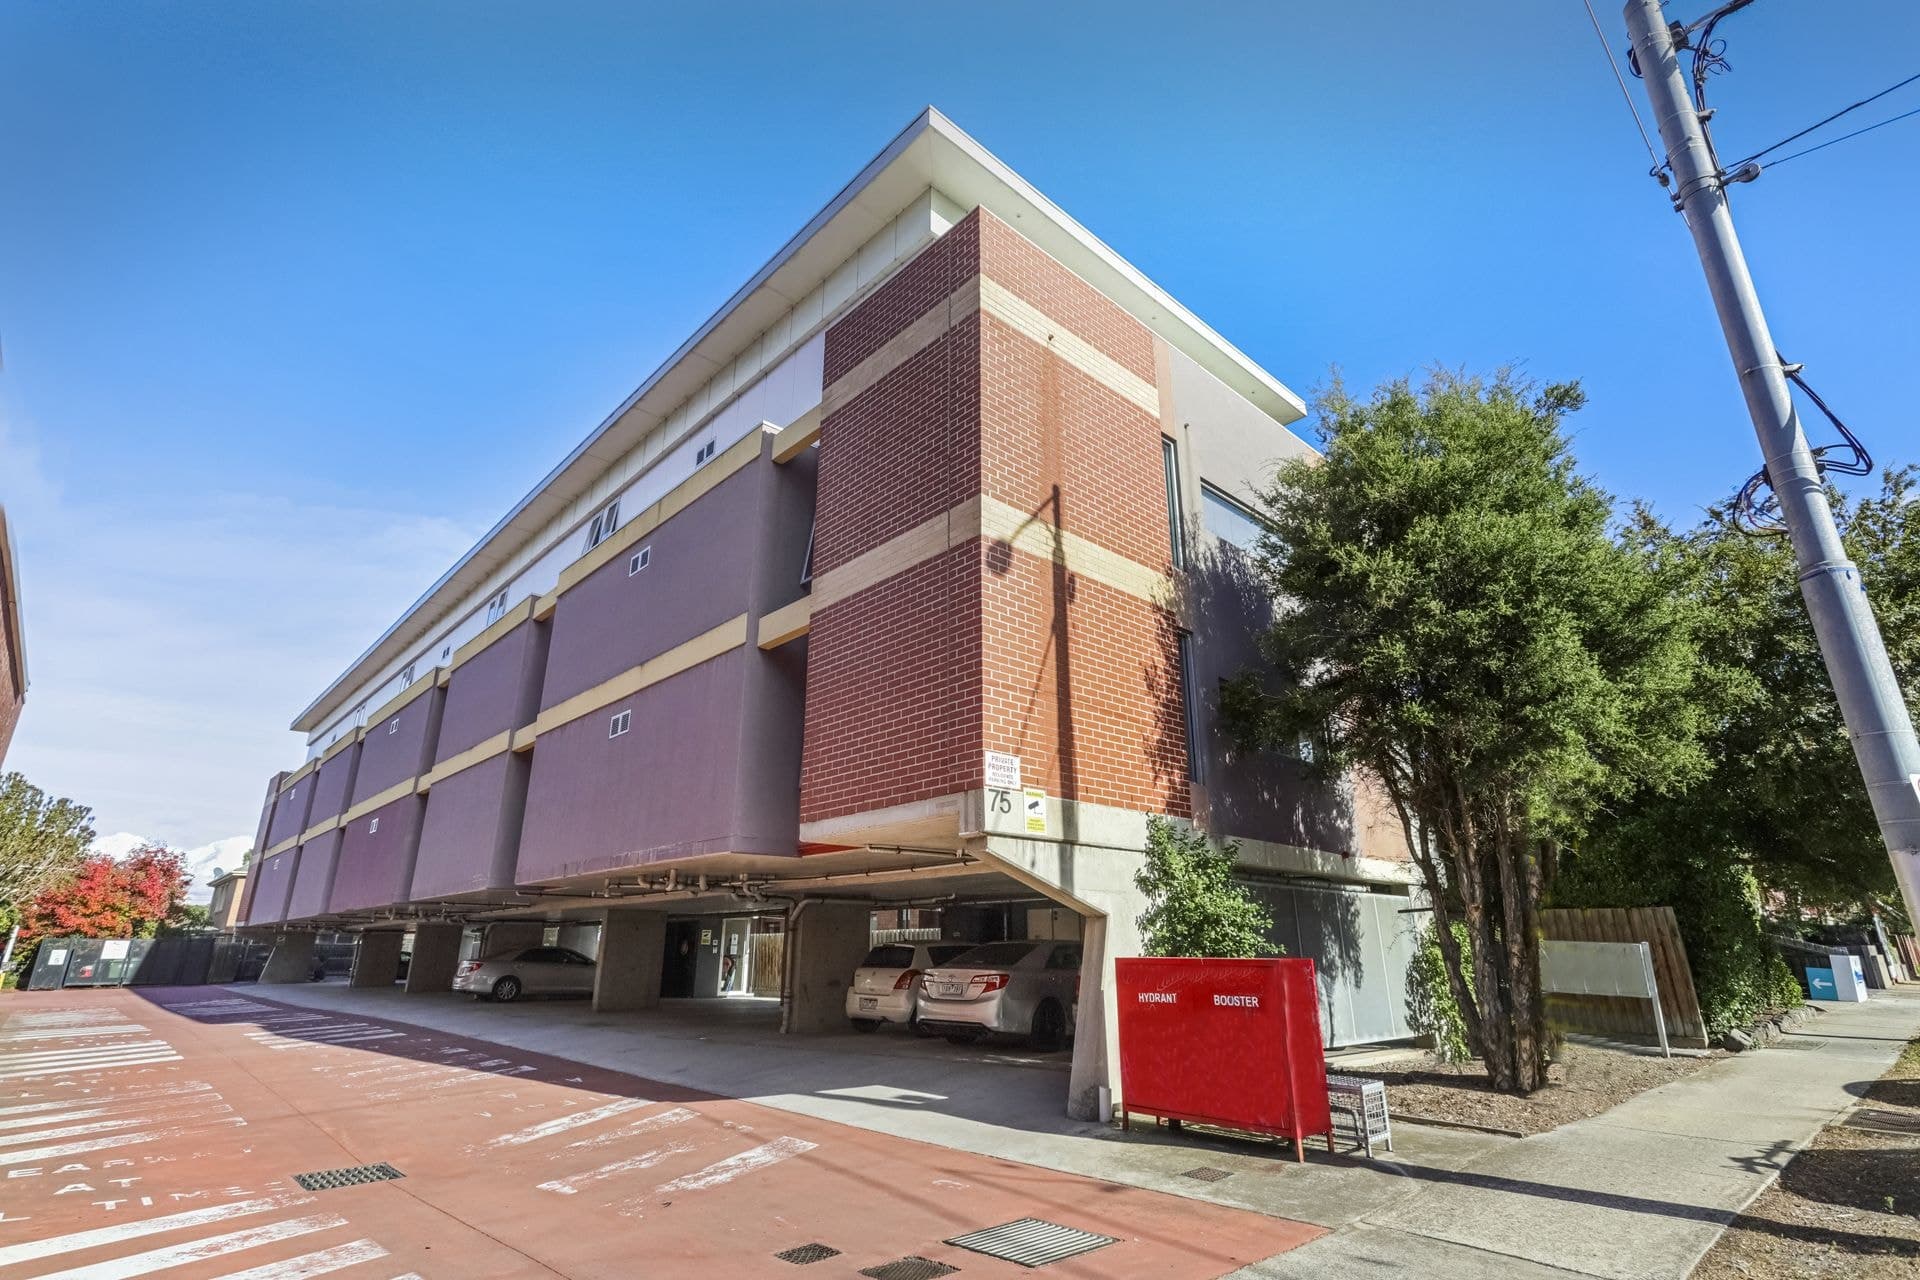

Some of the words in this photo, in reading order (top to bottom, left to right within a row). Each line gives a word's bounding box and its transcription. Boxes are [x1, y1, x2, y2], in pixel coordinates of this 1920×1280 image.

[988, 762, 1017, 774] PROPERTY
[991, 755, 1014, 767] PRIVATE
[988, 789, 1012, 814] 75
[1138, 992, 1177, 1004] HYDRANT
[1213, 994, 1259, 1008] BOOSTER
[53, 1177, 142, 1195] AT
